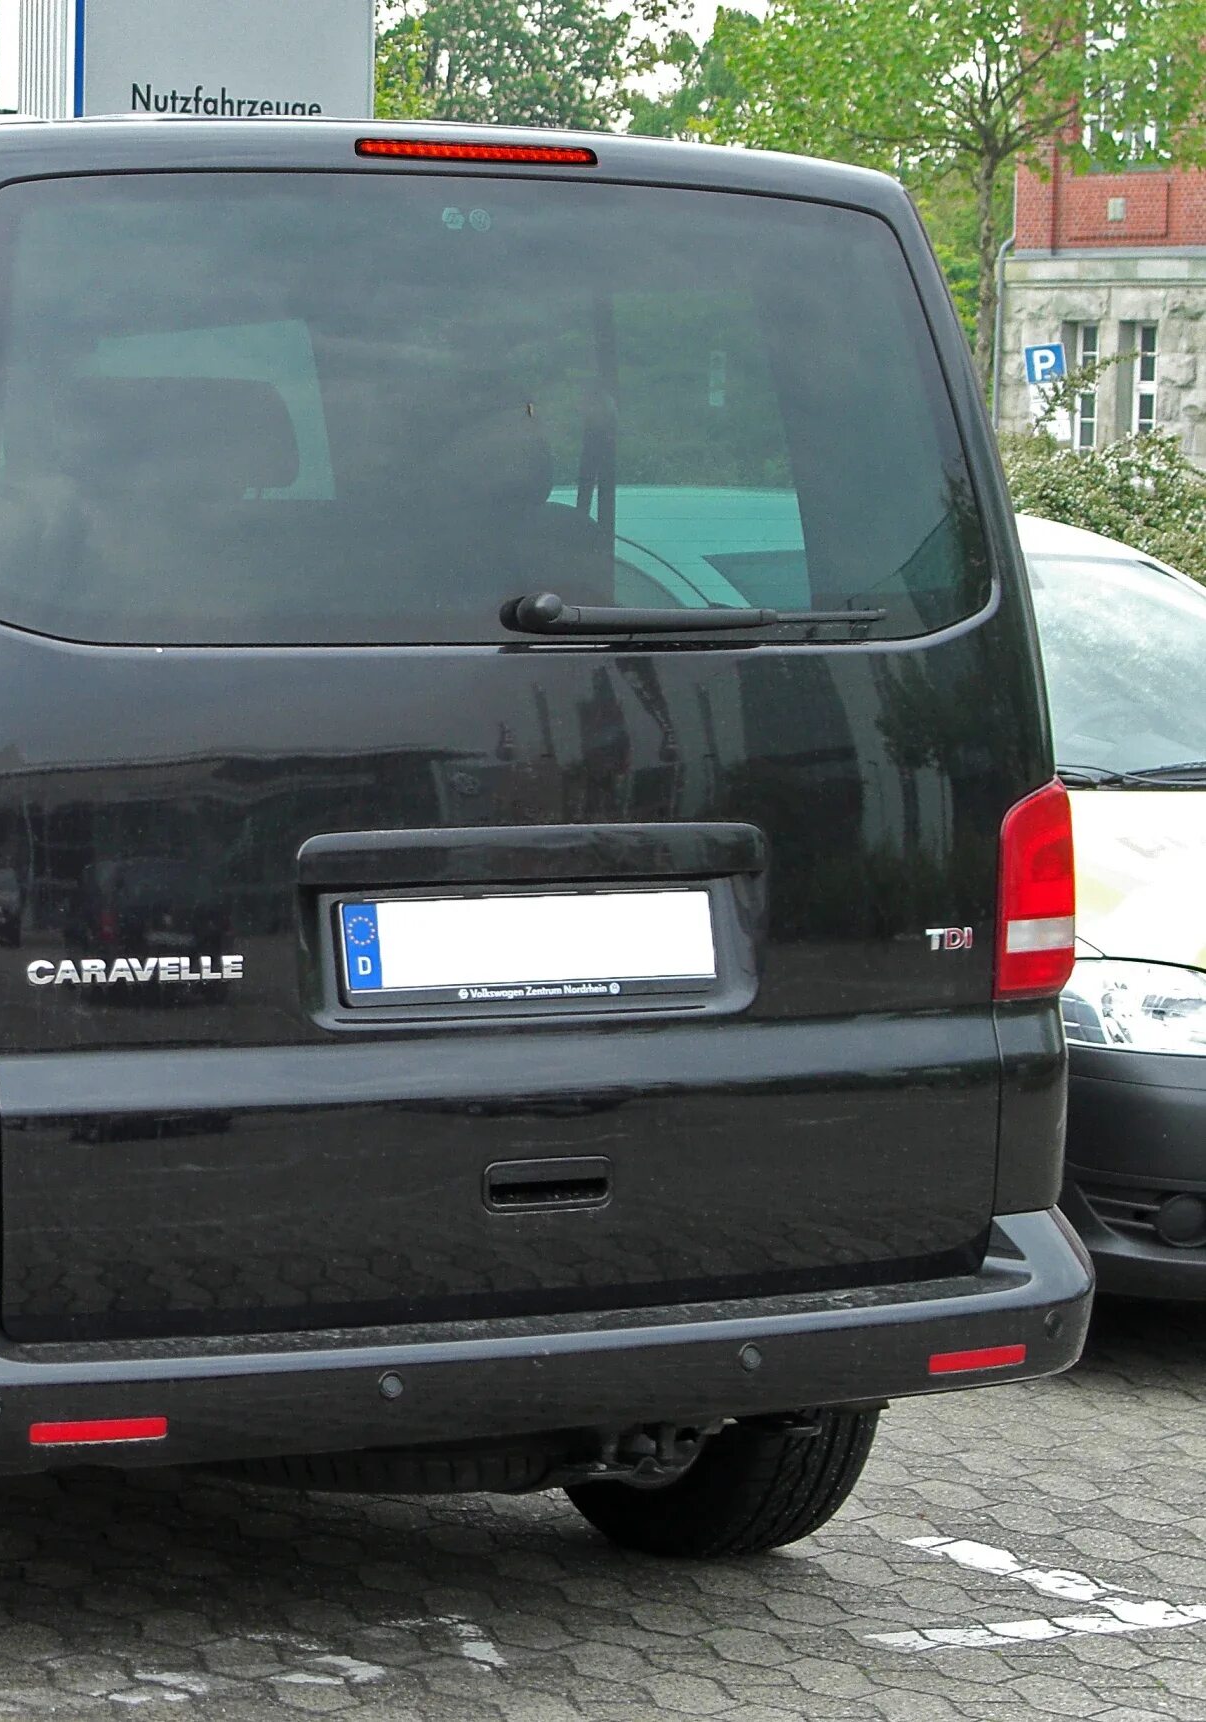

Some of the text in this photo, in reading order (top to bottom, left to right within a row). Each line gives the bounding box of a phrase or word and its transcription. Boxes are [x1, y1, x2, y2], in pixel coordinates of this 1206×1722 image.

[1032, 350, 1056, 381] P
[925, 926, 973, 951] TDI
[26, 955, 244, 985] CARAVELLE
[357, 956, 372, 976] D
[469, 987, 525, 999] Volkswagen
[526, 986, 563, 997] Zentrum
